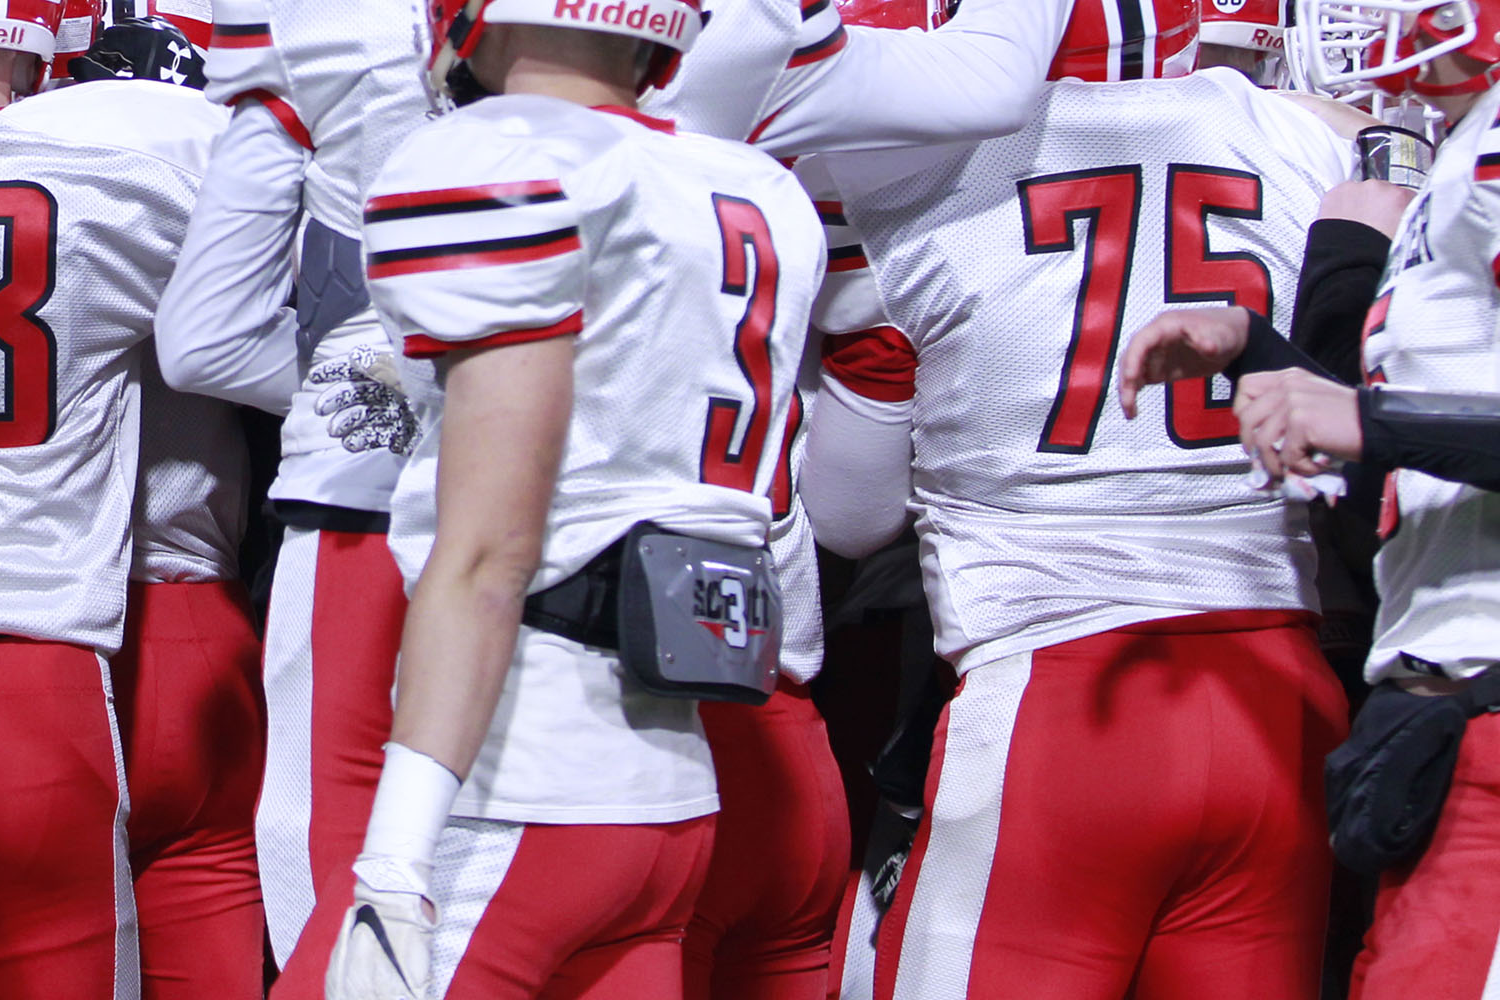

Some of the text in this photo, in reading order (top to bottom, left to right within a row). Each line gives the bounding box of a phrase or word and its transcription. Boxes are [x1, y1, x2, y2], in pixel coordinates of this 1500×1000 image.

[700, 192, 779, 496] 3
[1016, 162, 1274, 454] 75
[721, 575, 749, 650] 3
